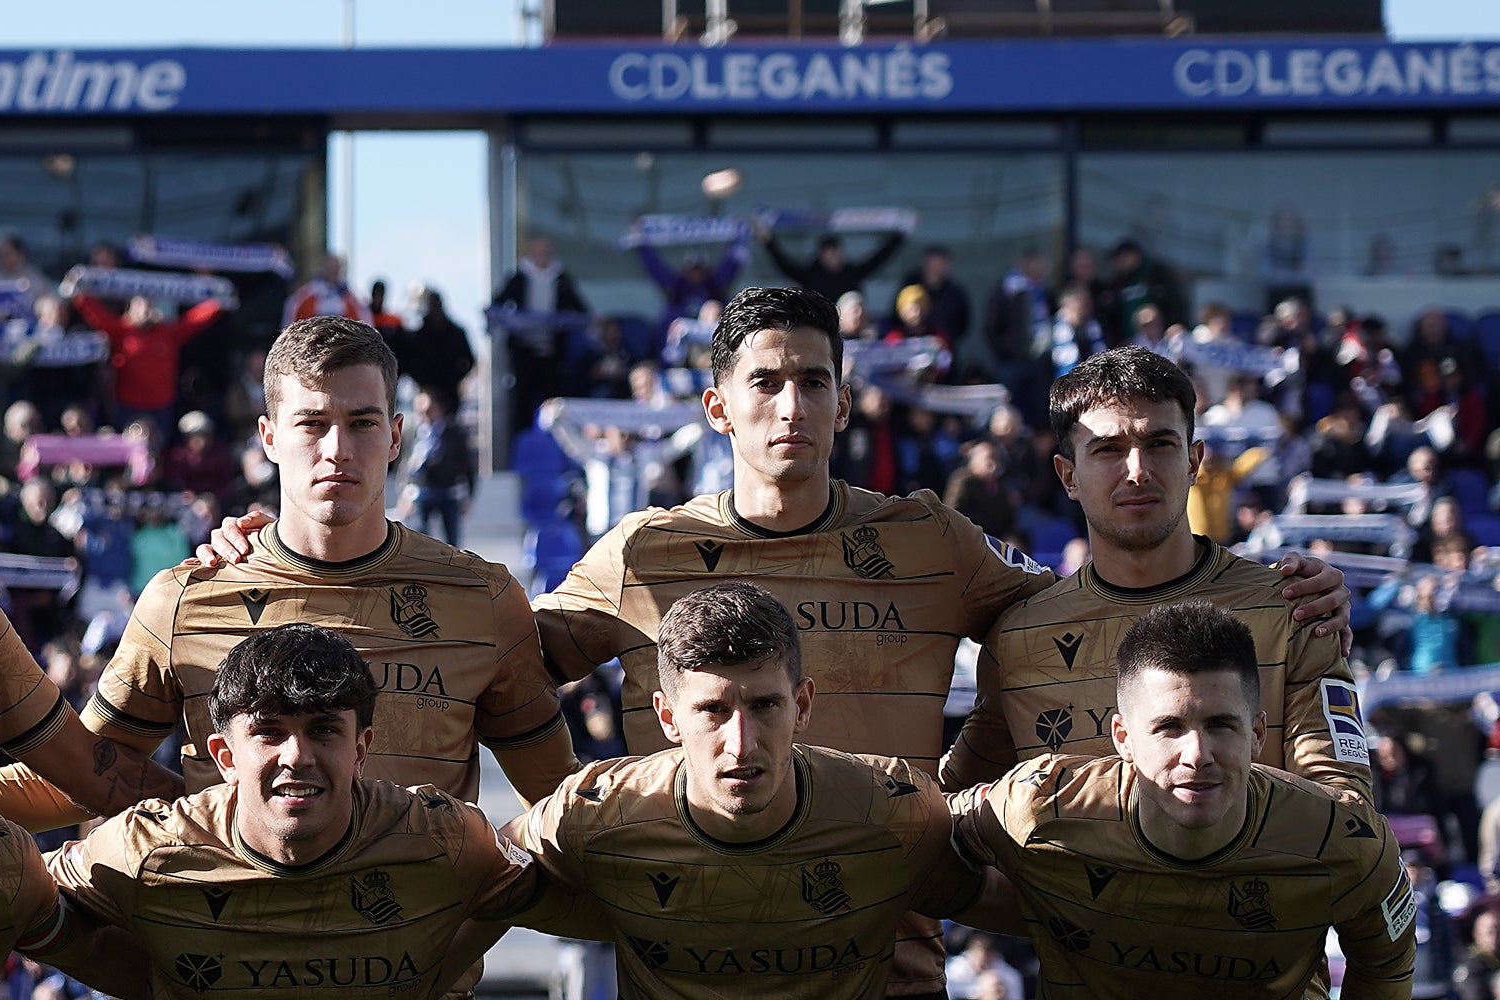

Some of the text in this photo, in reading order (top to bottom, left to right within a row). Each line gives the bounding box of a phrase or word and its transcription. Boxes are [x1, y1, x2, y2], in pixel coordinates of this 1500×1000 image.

[416, 697, 450, 712] group
[238, 950, 420, 987] YASUDA
[683, 938, 864, 973] YASUDA
[1108, 941, 1282, 978] YASUDA
